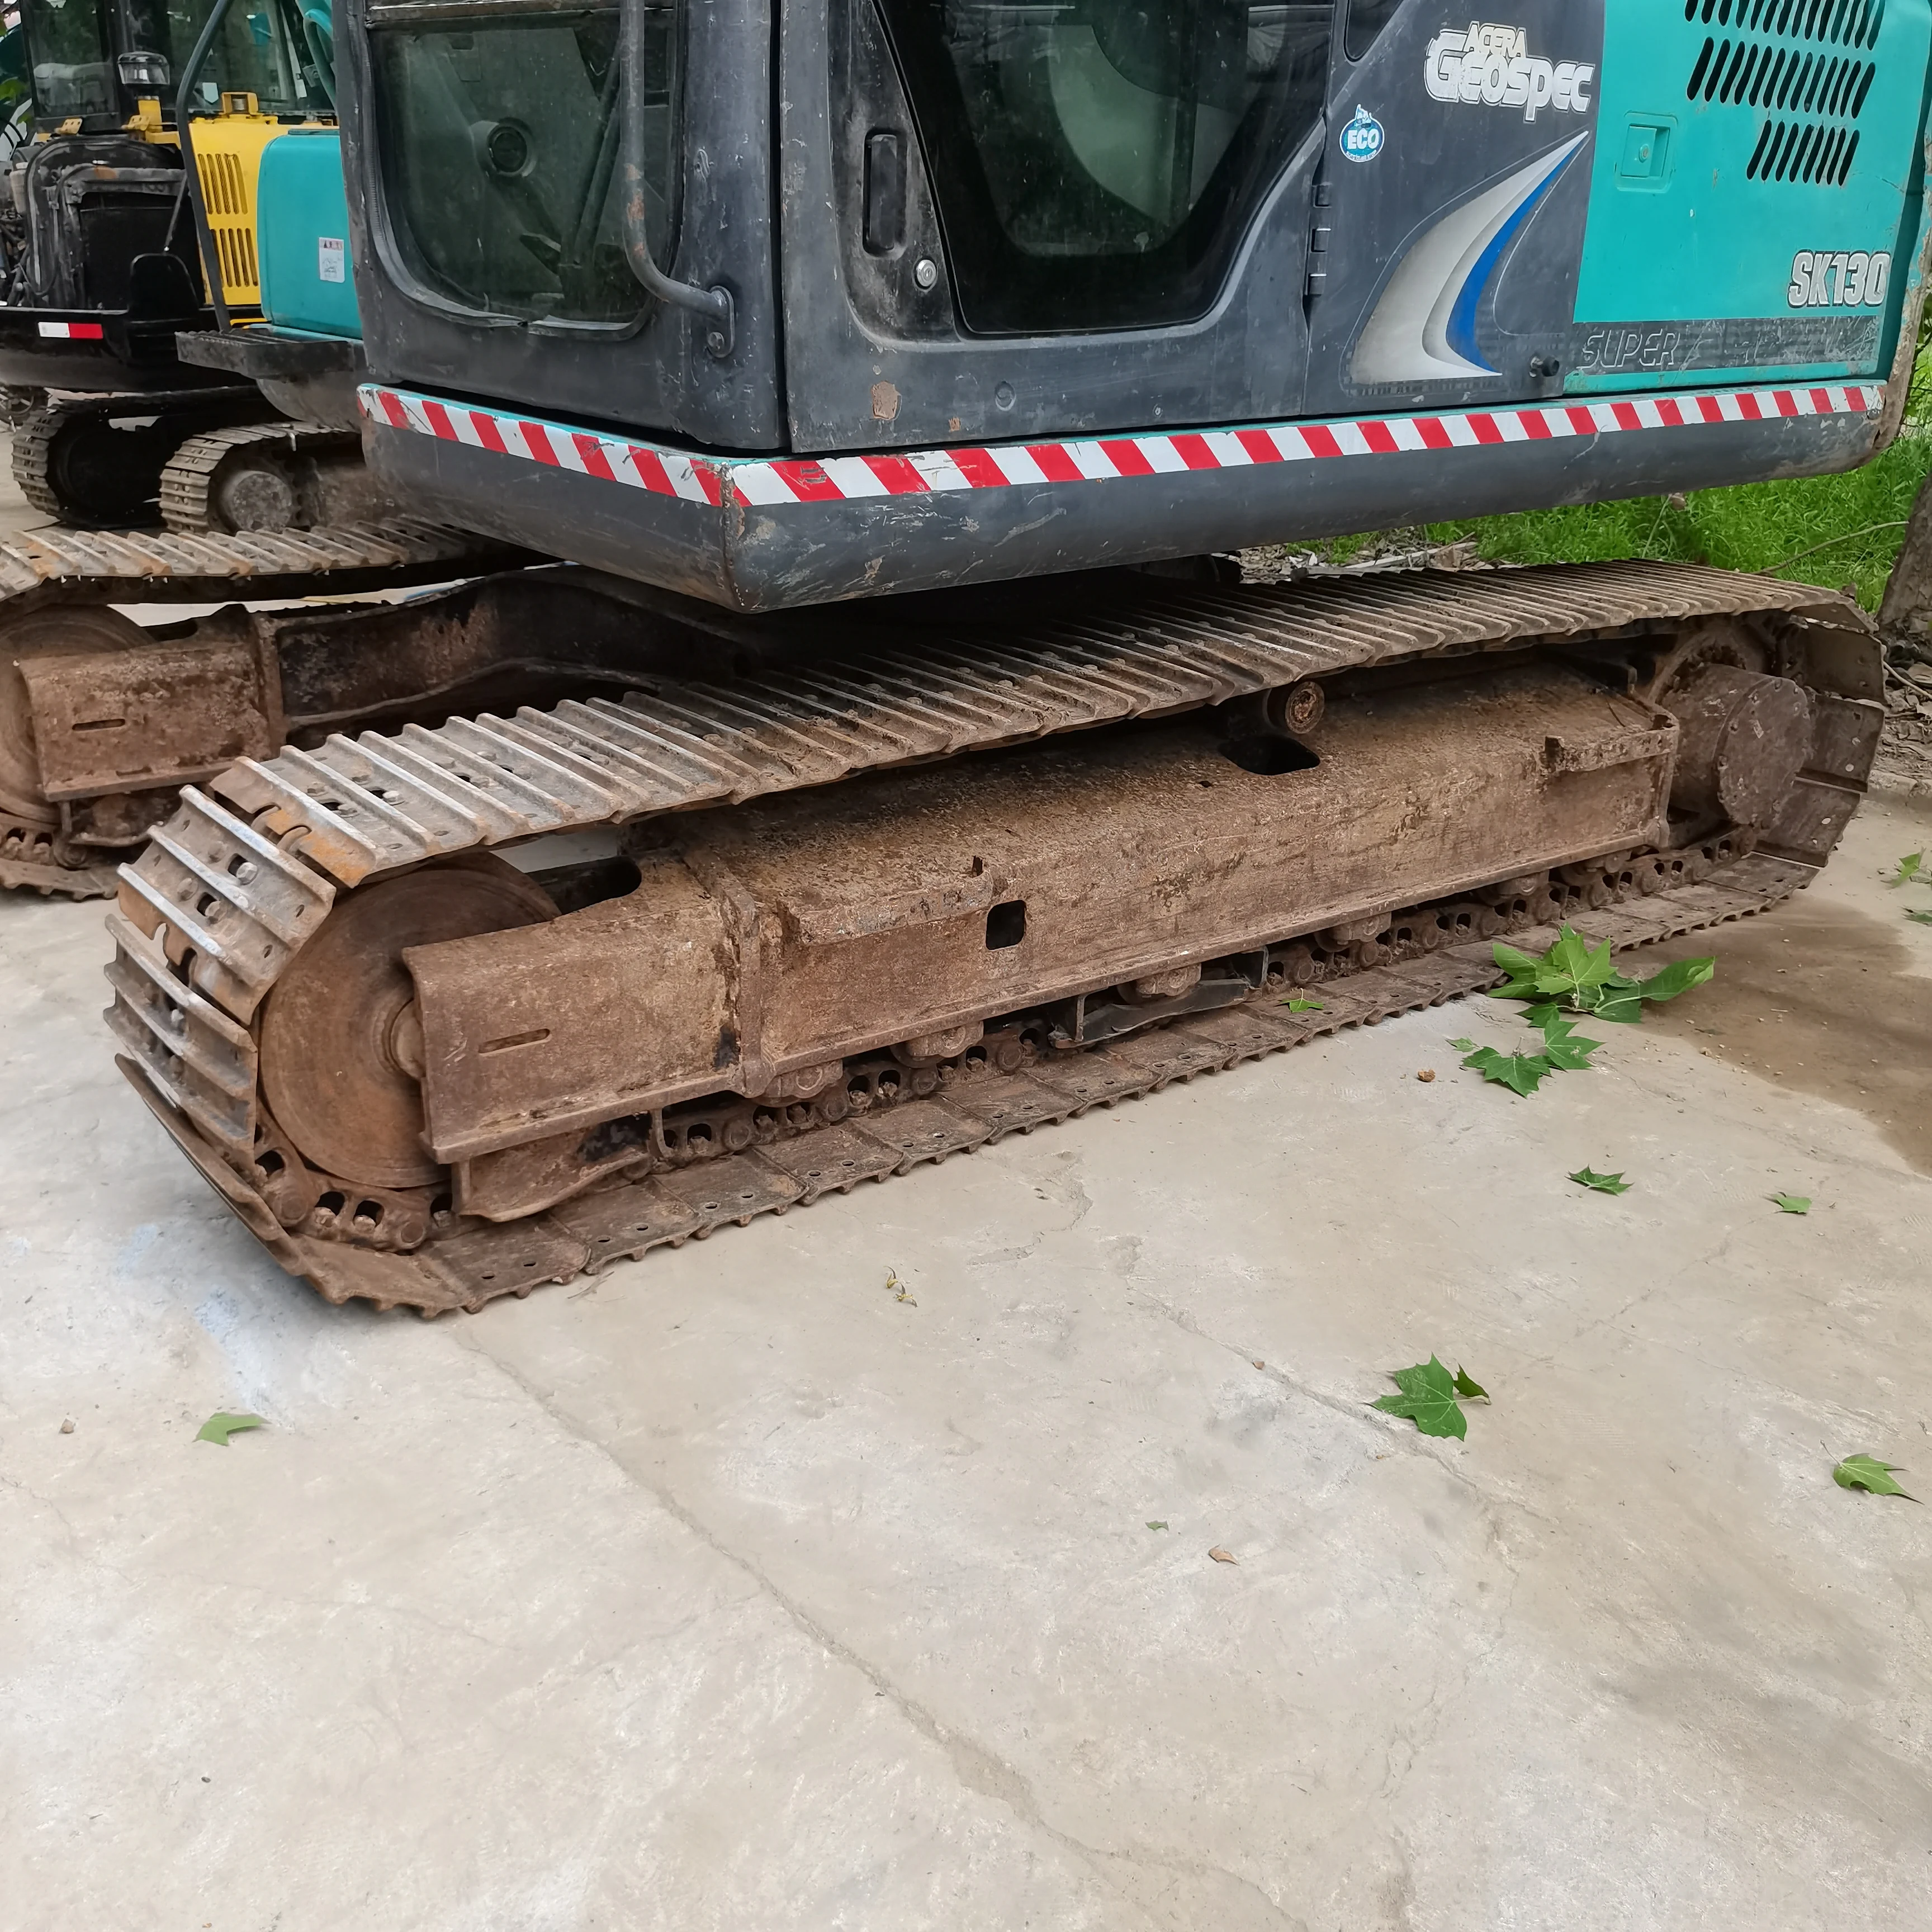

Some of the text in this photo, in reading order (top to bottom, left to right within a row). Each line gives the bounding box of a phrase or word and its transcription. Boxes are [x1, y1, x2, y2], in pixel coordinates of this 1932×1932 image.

[1461, 21, 1527, 59] ACERA
[1347, 128, 1379, 149] ECO
[1787, 249, 1891, 308] SK130
[1576, 328, 1680, 368] SUPER
